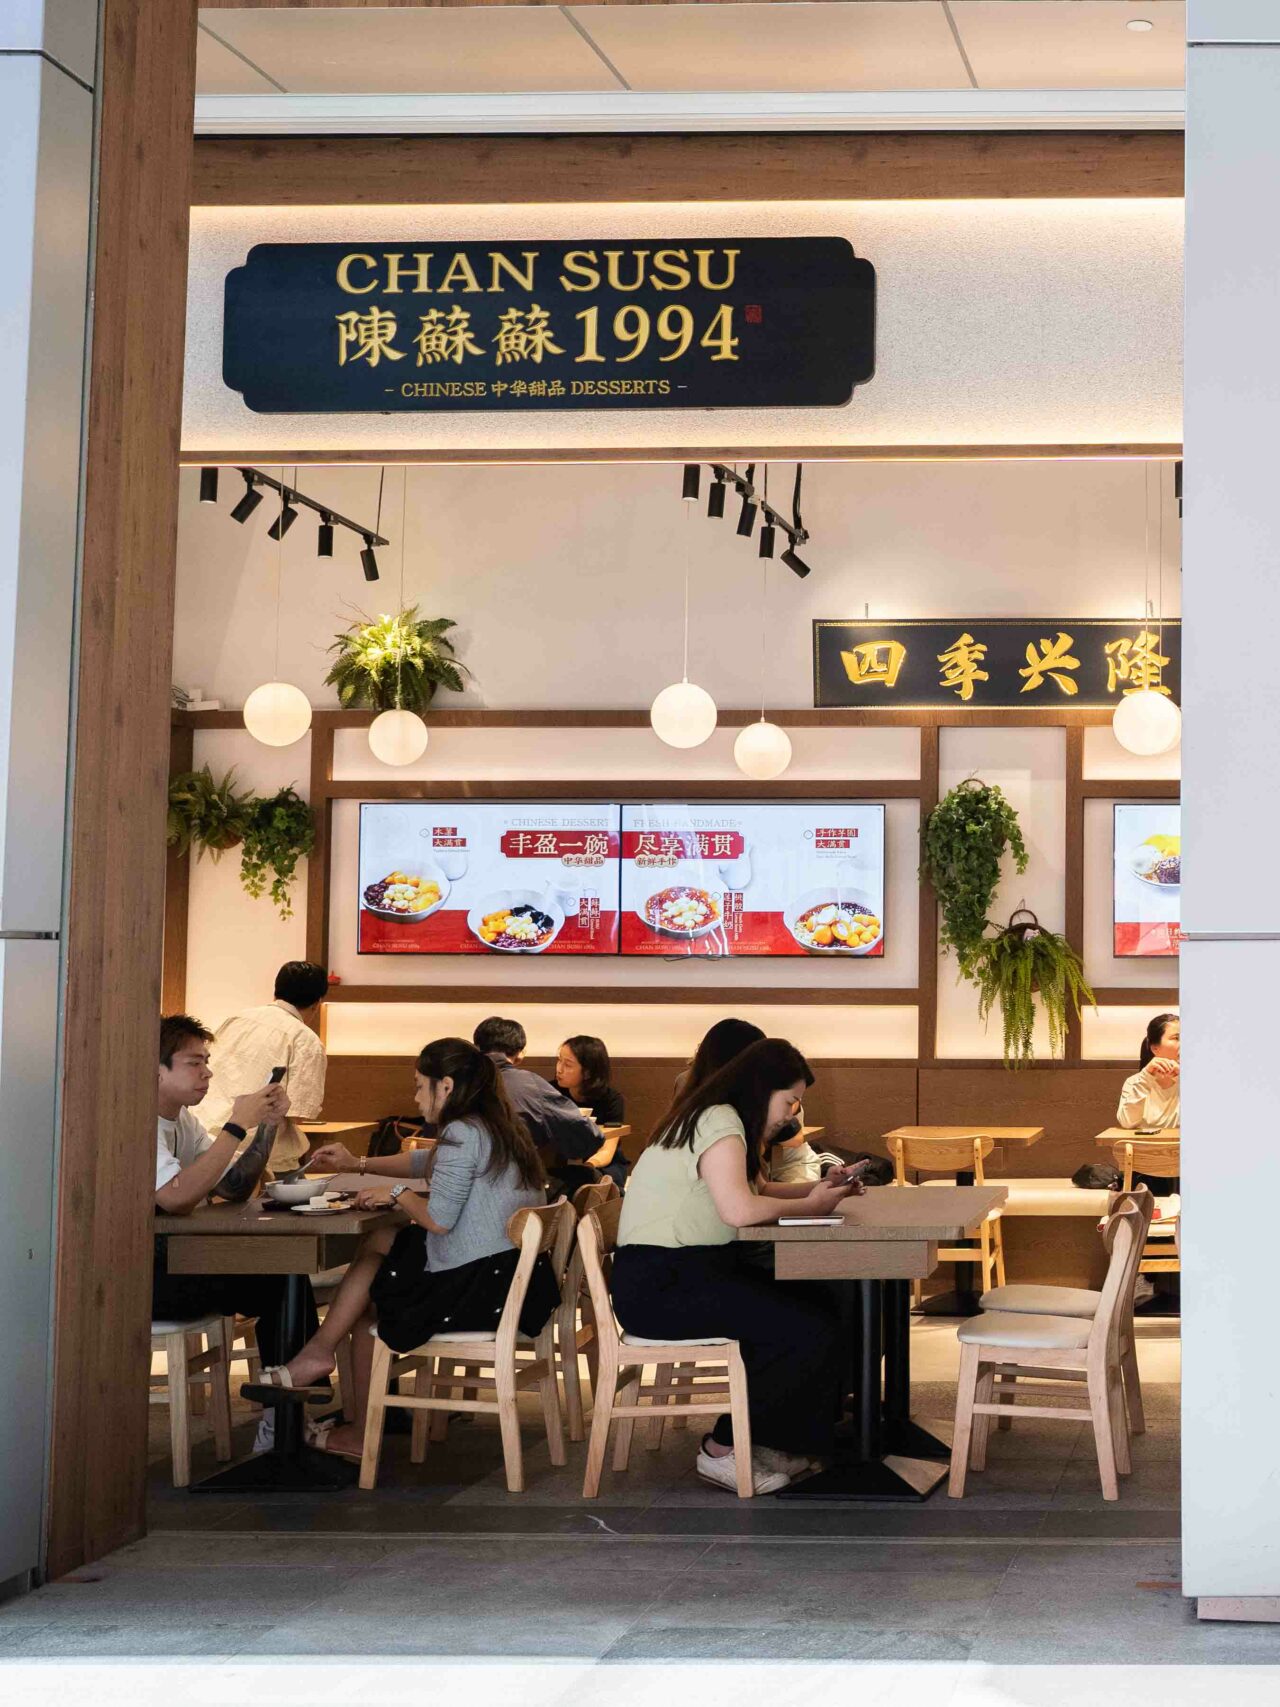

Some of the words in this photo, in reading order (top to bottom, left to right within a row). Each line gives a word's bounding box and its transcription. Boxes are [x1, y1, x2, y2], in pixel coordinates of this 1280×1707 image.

[335, 252, 535, 295] CHAN
[559, 249, 741, 292] SUSU
[335, 303, 741, 368] 陳蘇蘇1994
[401, 382, 487, 399] CHINESE
[490, 380, 565, 398] 中华甜品
[571, 379, 671, 396] DESSERTS
[840, 630, 1171, 700] 四季兴隆
[511, 818, 558, 827] CHINESE
[509, 833, 609, 855] 丰盈一碗
[633, 834, 734, 856] 尽享满贯
[563, 856, 603, 865] 中华甜品
